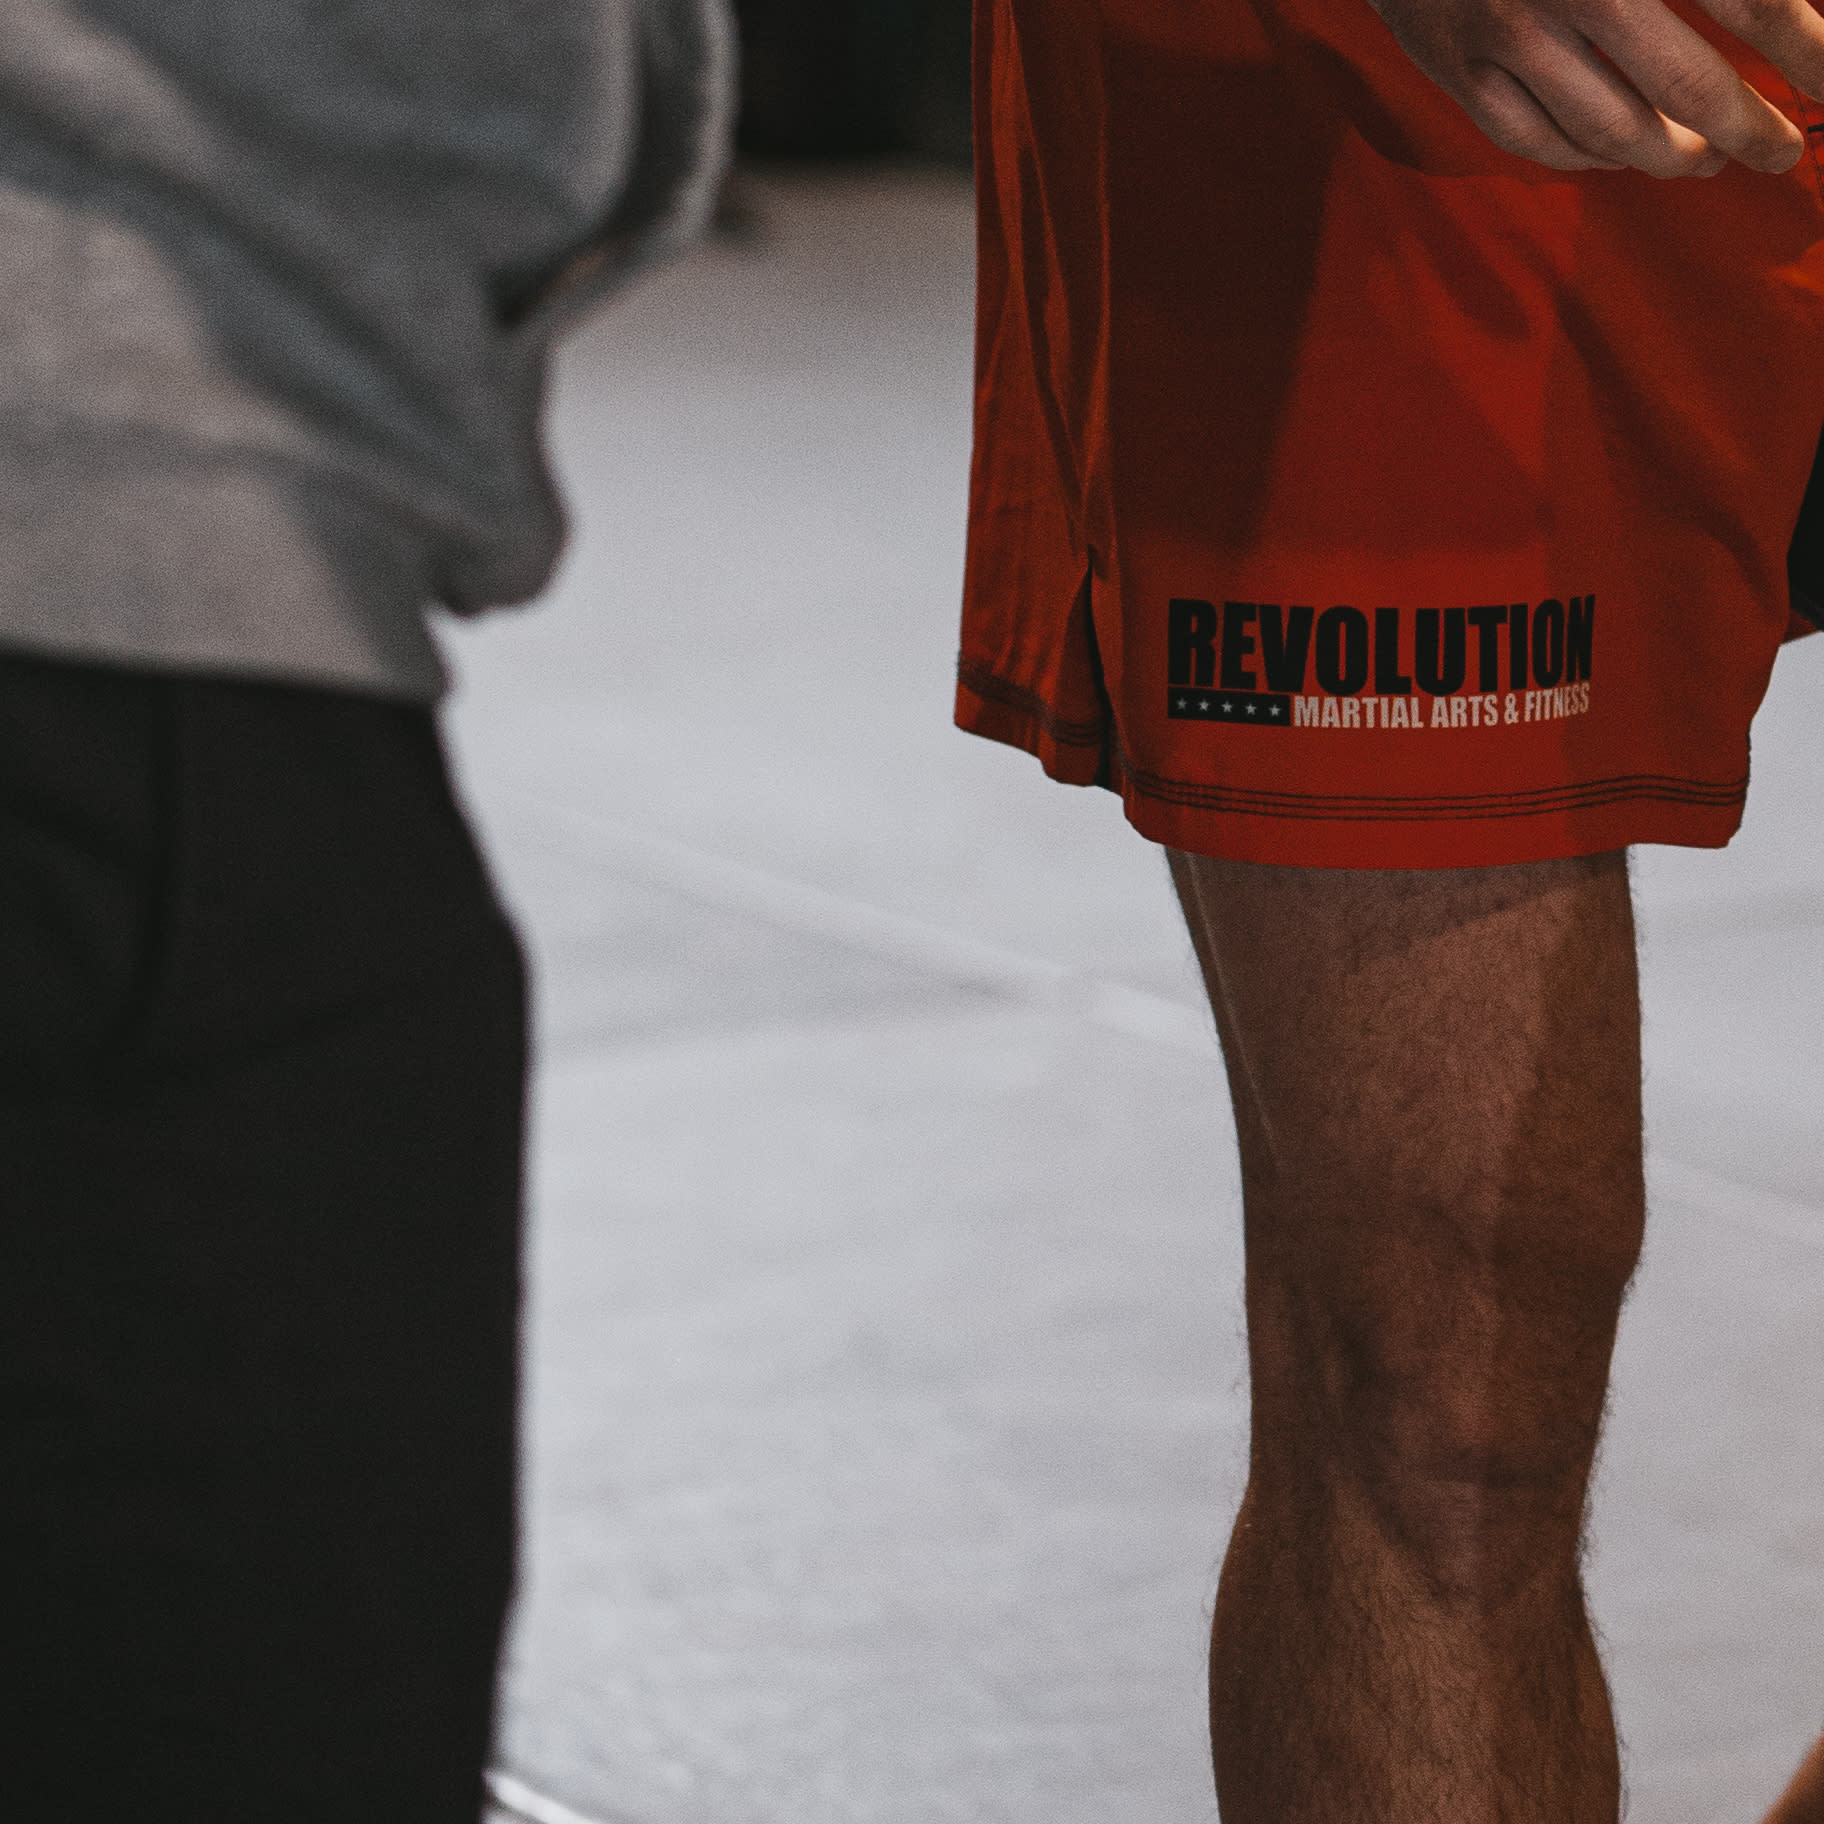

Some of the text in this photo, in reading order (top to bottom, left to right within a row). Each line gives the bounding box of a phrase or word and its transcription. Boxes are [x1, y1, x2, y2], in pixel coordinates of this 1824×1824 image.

[1167, 594, 1596, 696] REVOLUTION
[1294, 682, 1590, 729] MARTIAL ARTS & FITNESS
